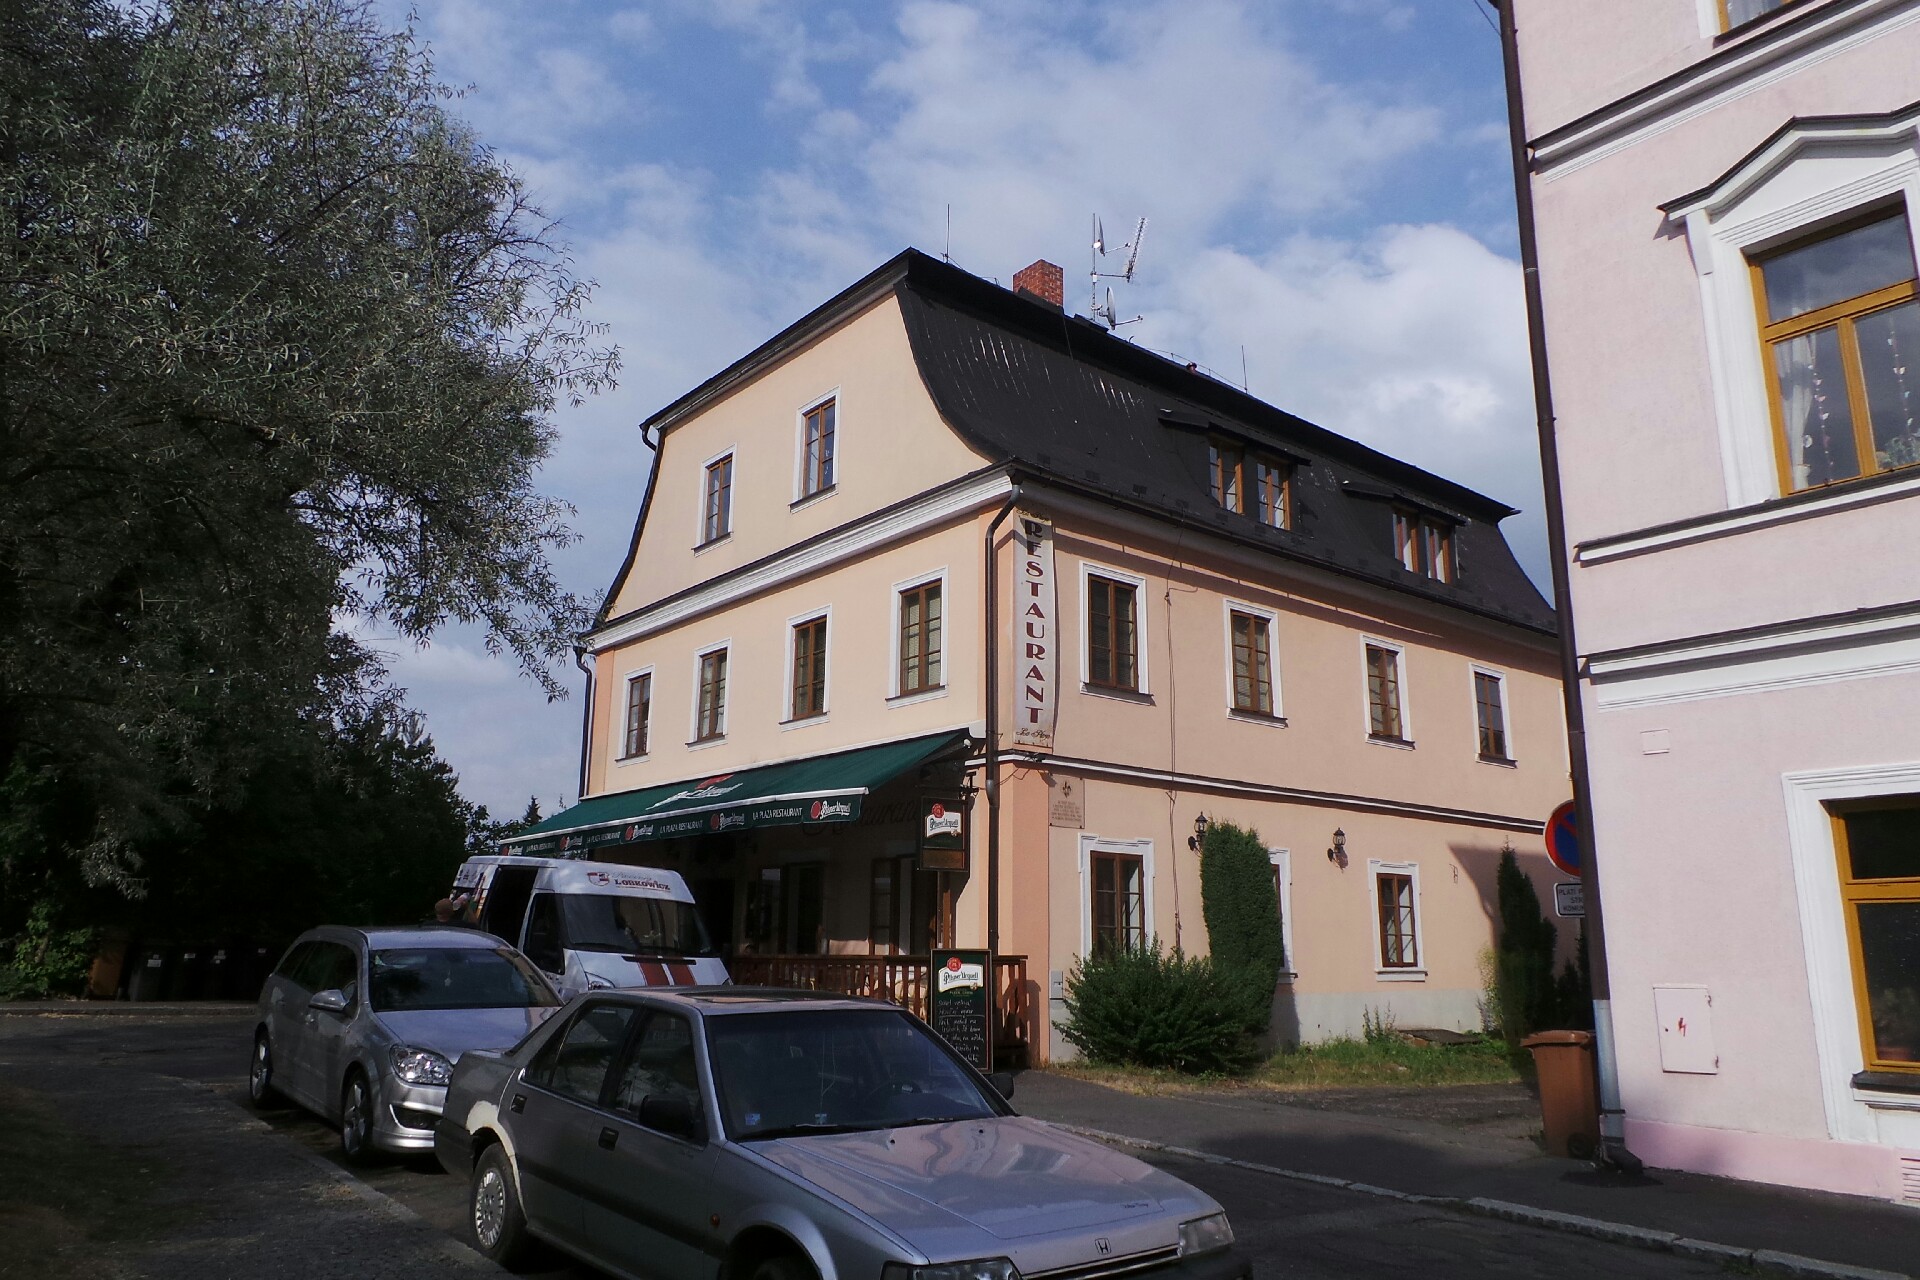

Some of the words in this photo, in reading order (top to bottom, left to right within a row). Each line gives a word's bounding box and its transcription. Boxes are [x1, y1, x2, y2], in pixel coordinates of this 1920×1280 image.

[1025, 518, 1046, 724] RESTAURANT
[760, 809, 773, 820] PLAZA
[773, 807, 803, 819] RESTAURANT
